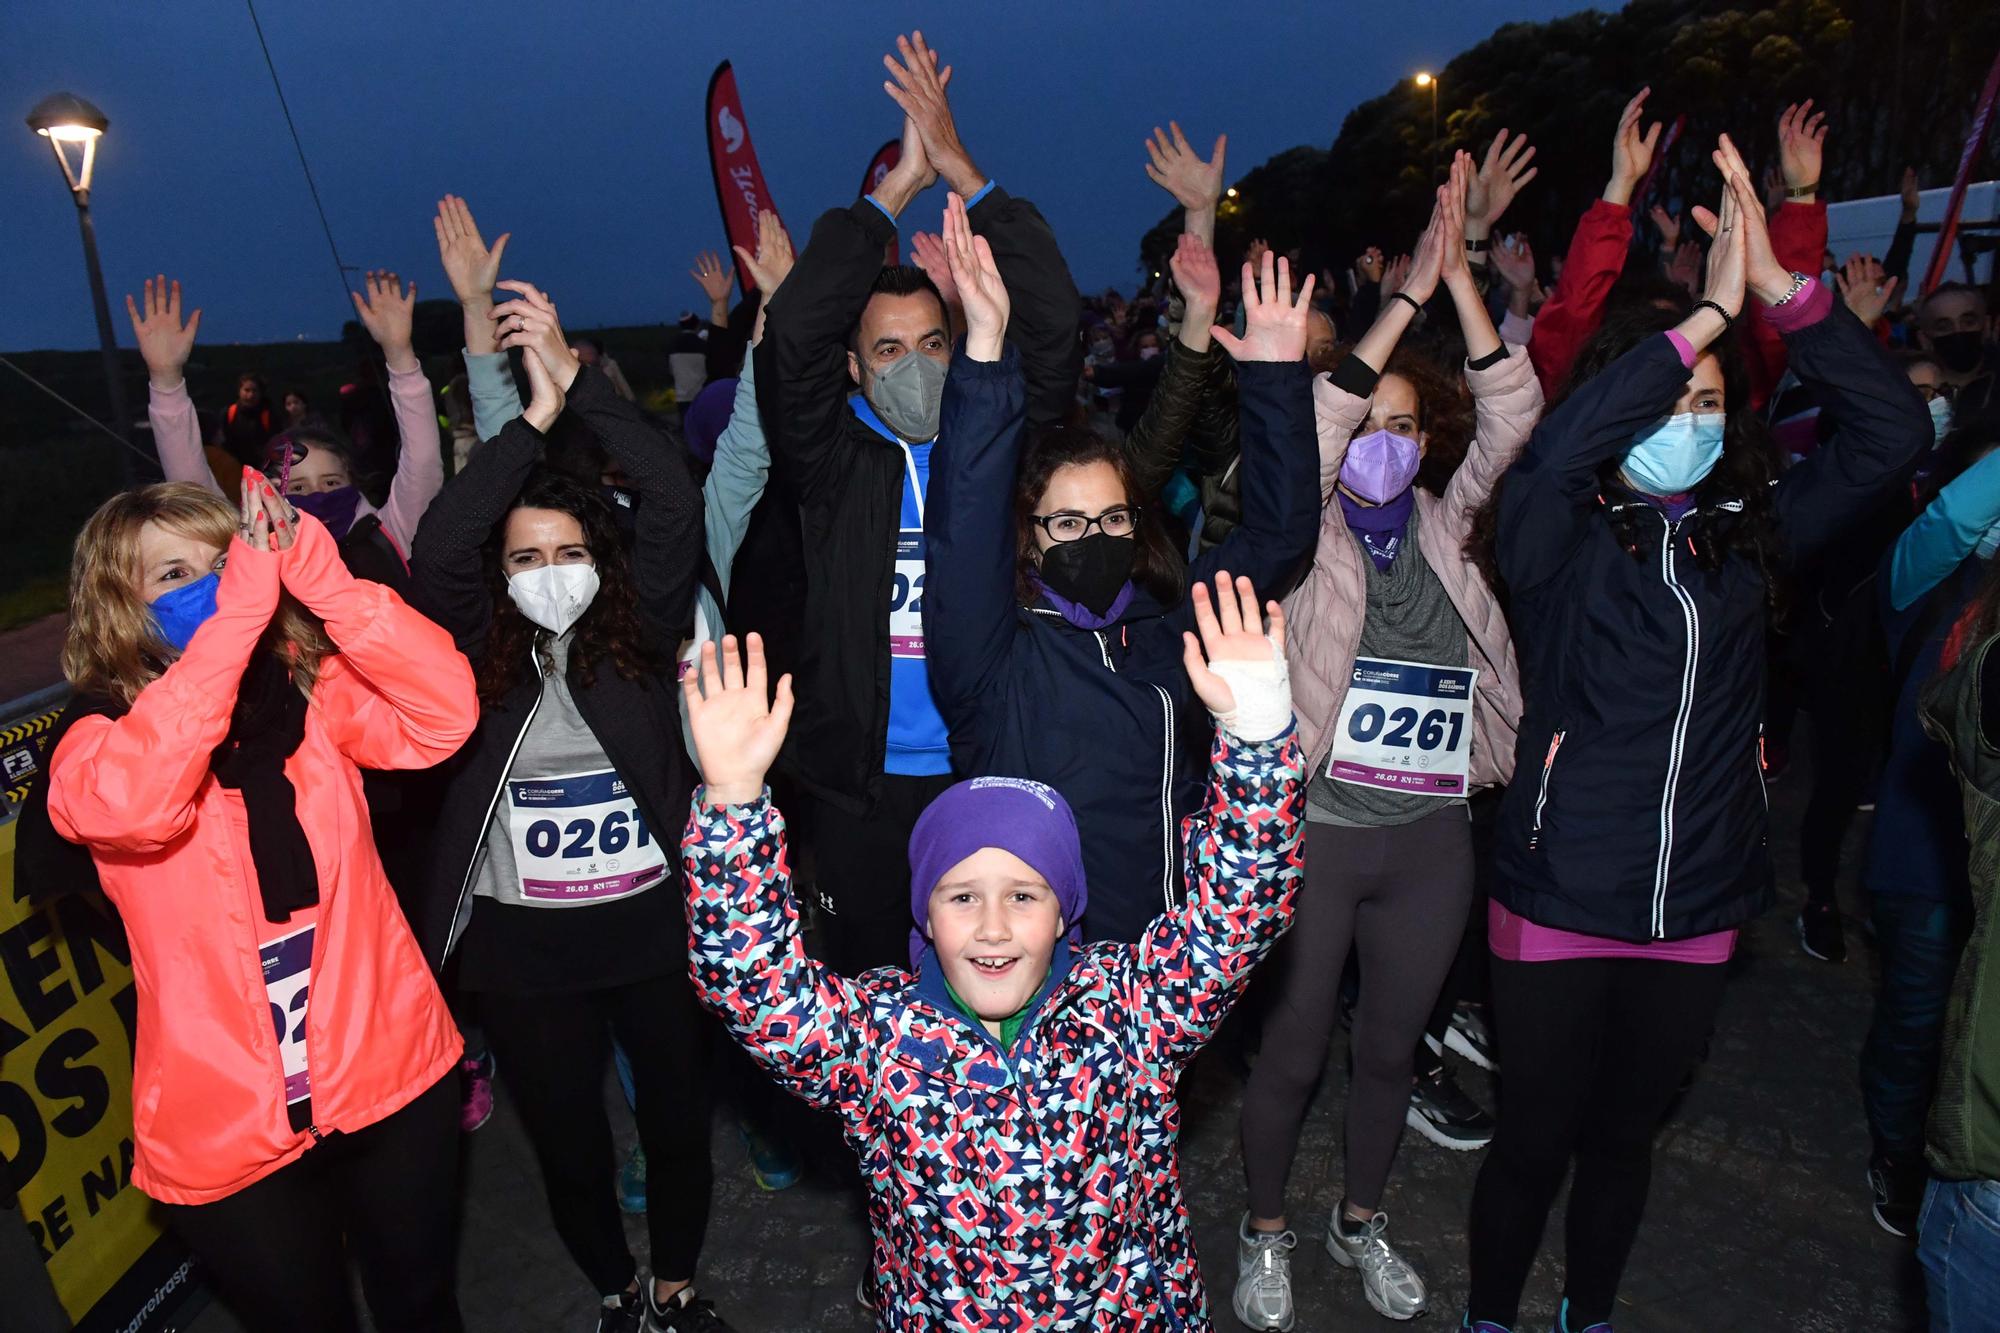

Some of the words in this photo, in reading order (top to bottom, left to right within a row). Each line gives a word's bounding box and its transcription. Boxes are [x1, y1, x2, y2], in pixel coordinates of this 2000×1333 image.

[1348, 702, 1464, 751] 0261
[3, 749, 33, 774] F3
[1374, 773, 1397, 782] 26.03
[526, 807, 649, 858] 0261
